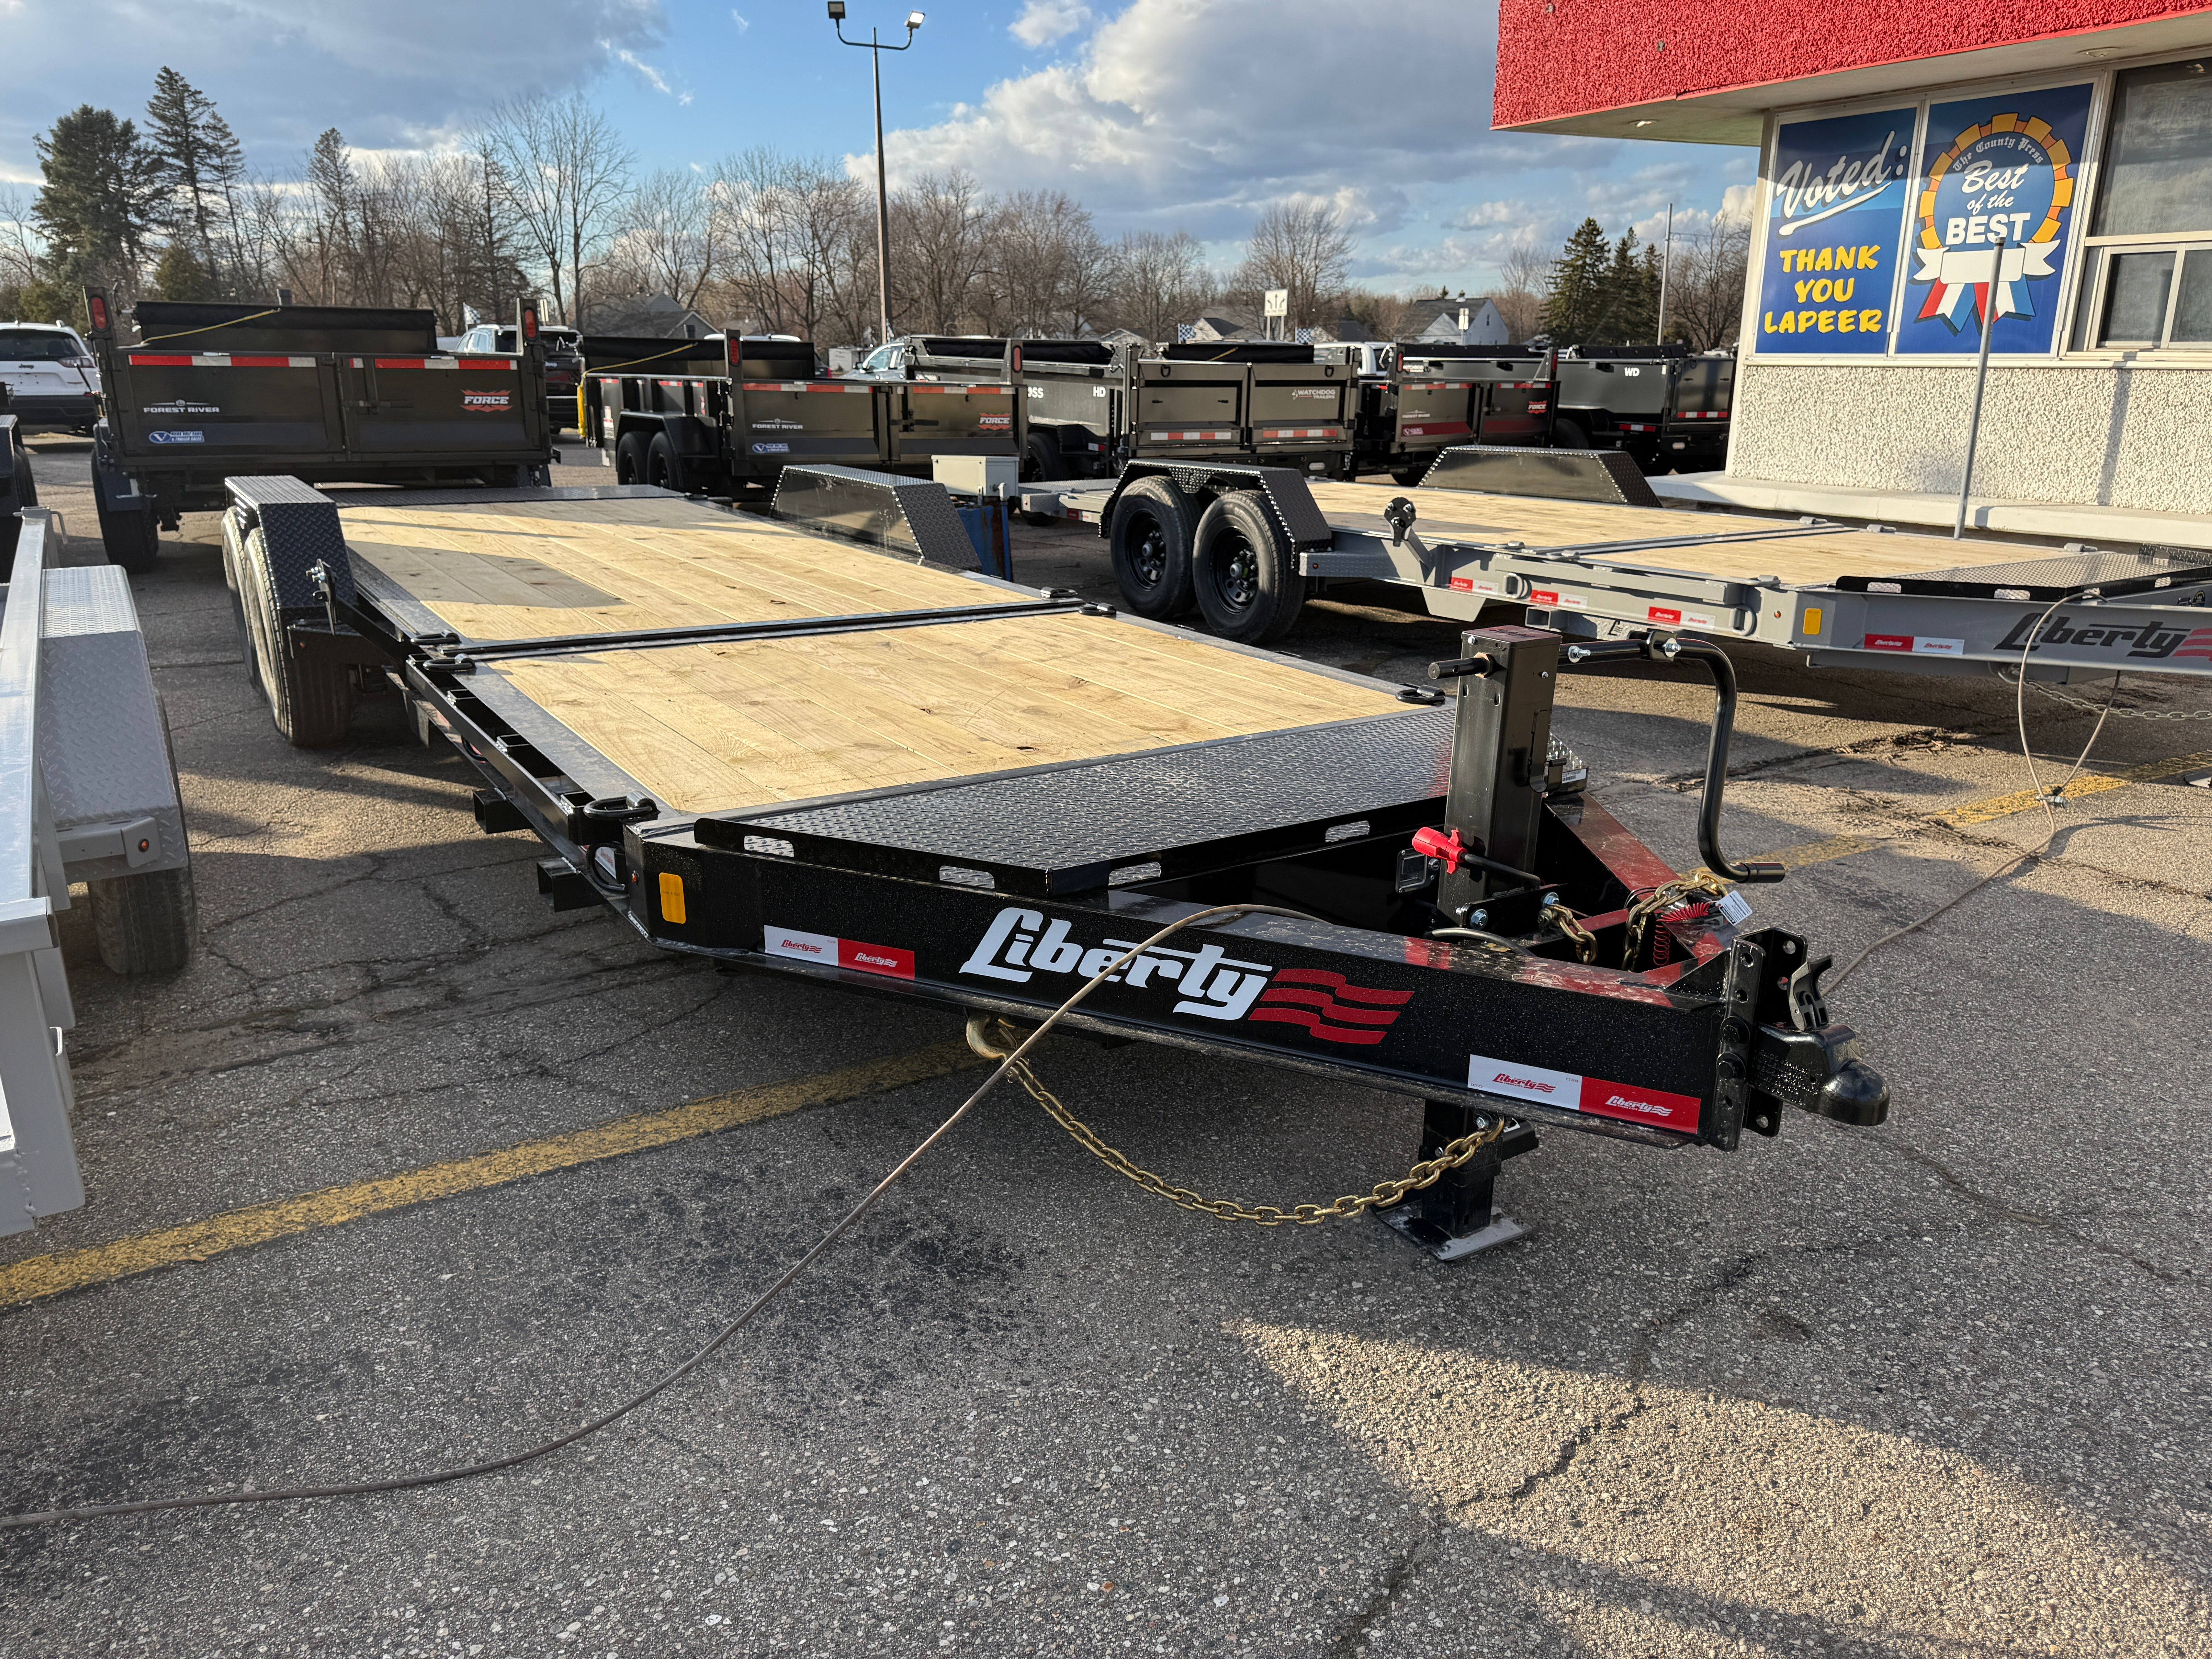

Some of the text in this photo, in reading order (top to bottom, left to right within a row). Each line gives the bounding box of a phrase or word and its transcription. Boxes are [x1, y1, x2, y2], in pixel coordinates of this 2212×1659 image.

[1953, 136, 2044, 171] The County Press
[1776, 131, 1907, 218] Voted:
[1961, 160, 2029, 193] Best
[1967, 190, 2014, 215] of the
[1945, 213, 2031, 245] BEST
[1780, 245, 1881, 273] THANK
[1795, 277, 1855, 303] YOU
[1764, 309, 1882, 333] LAPEER
[1625, 367, 1640, 377] WD
[1093, 386, 1106, 397] HD
[1994, 613, 2191, 658] Liberty
[781, 939, 810, 951] Liberty
[855, 953, 885, 965] Liberty
[960, 907, 1273, 1020] Liberty
[1492, 1073, 1537, 1089] Liberty
[1605, 1096, 1653, 1113] Liberty
